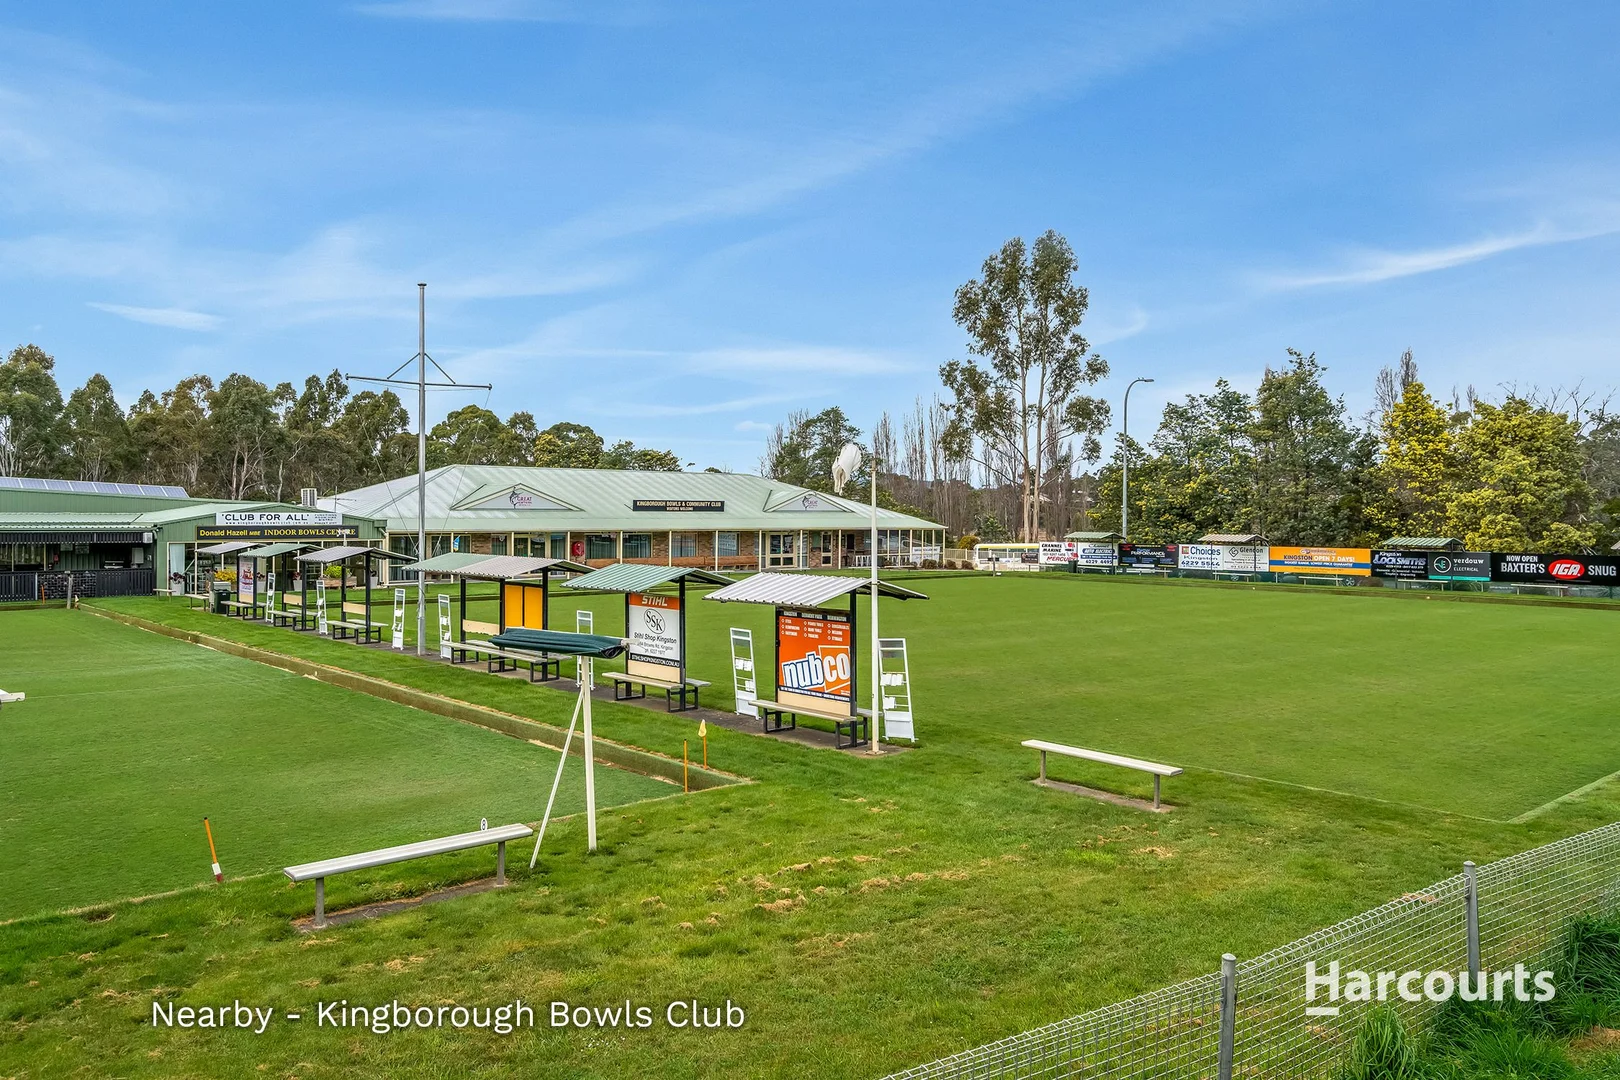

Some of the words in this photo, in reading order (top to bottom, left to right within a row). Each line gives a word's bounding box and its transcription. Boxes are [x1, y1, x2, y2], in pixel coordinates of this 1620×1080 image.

[199, 529, 225, 537] Donald
[1190, 546, 1221, 556] Choices
[1501, 563, 1545, 573] BAXTER'S
[1588, 565, 1617, 576] SNUG
[641, 595, 668, 606] STIHL
[646, 610, 662, 631] SSK
[644, 633, 656, 642] Shop
[656, 635, 677, 645] Kingston
[783, 652, 850, 688] nubco
